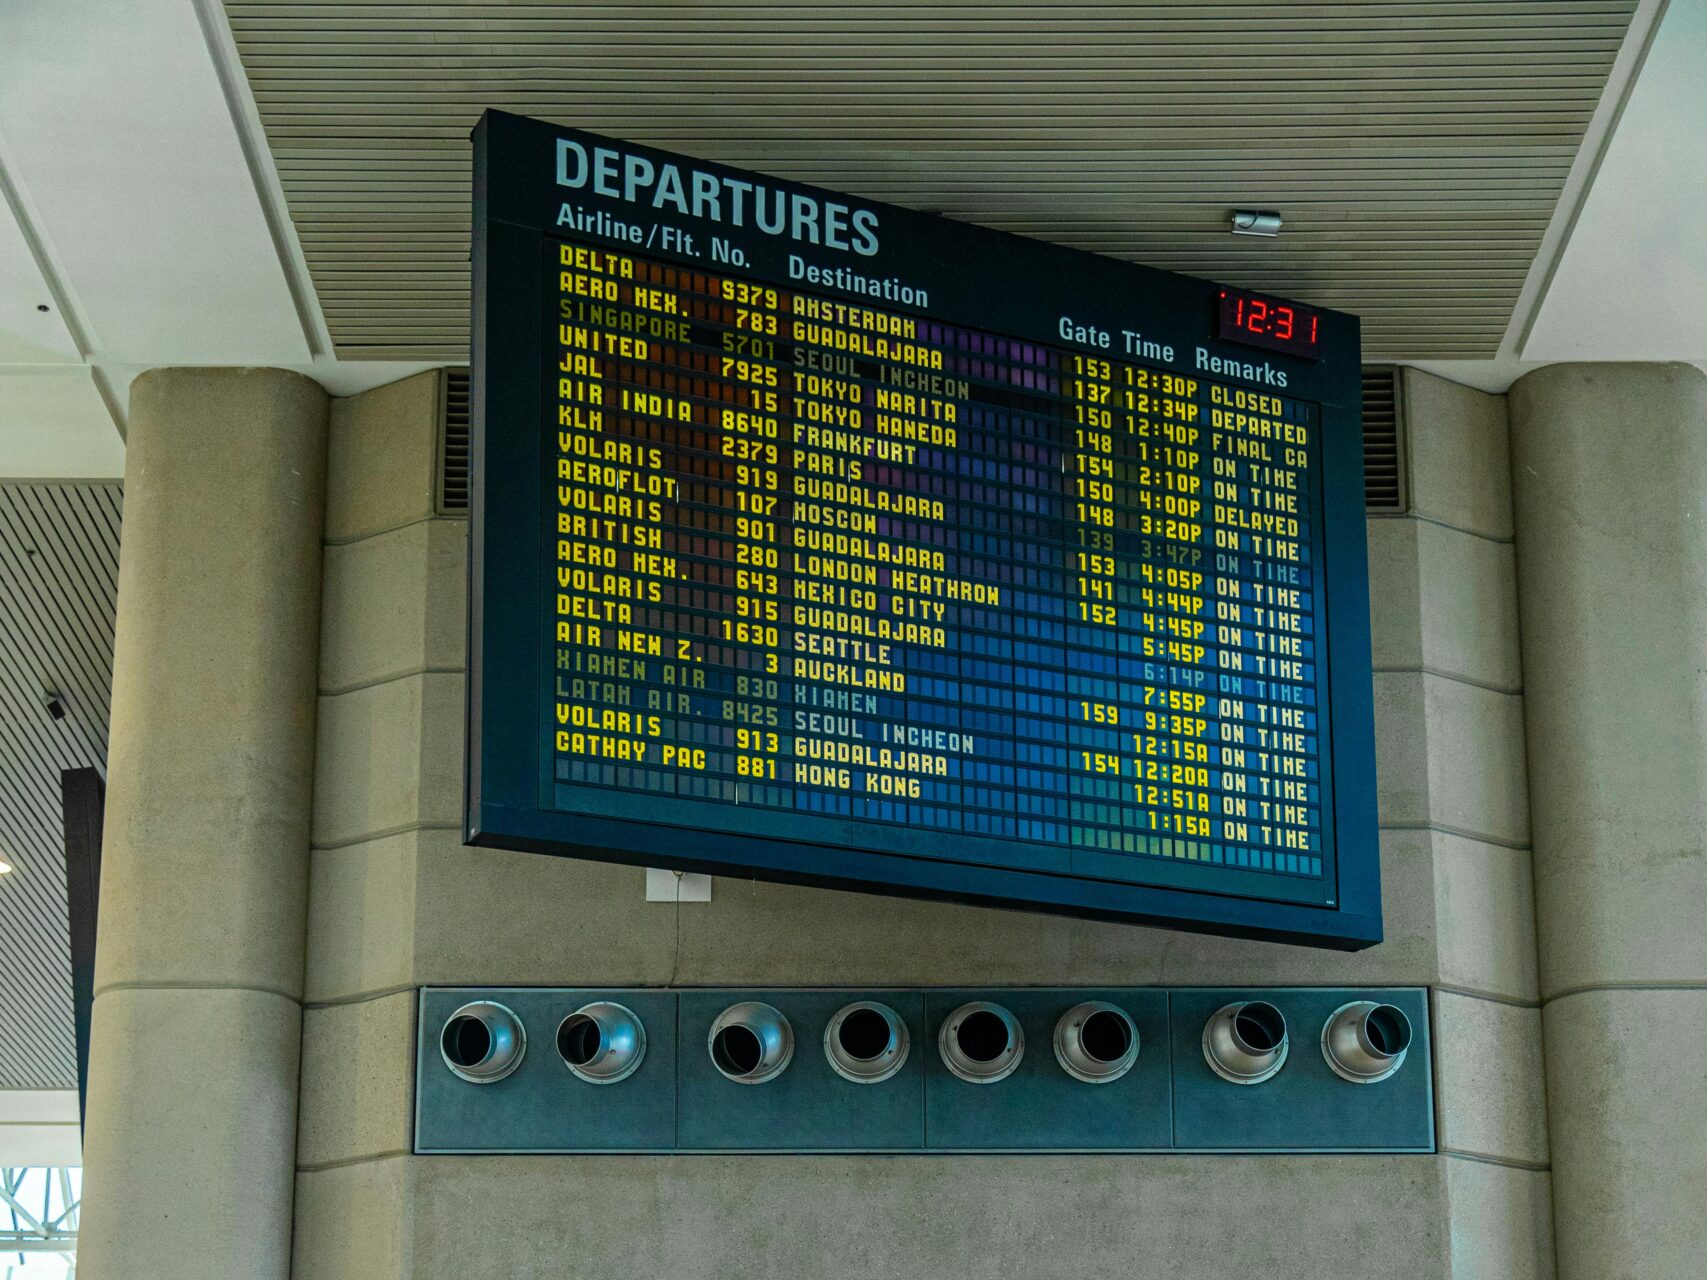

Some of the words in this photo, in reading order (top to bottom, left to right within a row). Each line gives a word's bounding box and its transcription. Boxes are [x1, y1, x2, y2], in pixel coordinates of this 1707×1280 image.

[556, 138, 880, 256] DEPARTURES
[556, 203, 700, 258] Airline/Flt.
[712, 236, 751, 269] No.
[789, 255, 928, 308] Destination
[1059, 317, 1110, 349] Gate
[1122, 330, 1174, 362] Time
[1196, 347, 1288, 388] Remarks
[560, 245, 633, 280] DELTA
[792, 295, 913, 339] AMSTERDAM
[1074, 355, 1110, 381] 153
[1124, 366, 1197, 399] 12:30P
[1211, 384, 1281, 417] CLOSED
[560, 271, 618, 303] AERO
[634, 287, 690, 318] MEX.
[736, 308, 777, 336] 783
[792, 320, 940, 370] GUADALAJARA
[1075, 379, 1110, 405] 137
[1125, 390, 1198, 423] 12:34P
[1212, 408, 1306, 445] DEPARTED
[1236, 299, 1317, 344] 12:31
[559, 351, 603, 379] JAL
[751, 388, 777, 413] 15
[793, 397, 861, 429] TOKYO
[876, 413, 956, 448] HANEDA
[1076, 452, 1112, 478] 154
[1139, 465, 1200, 495] 2:10P
[559, 377, 603, 405] AIR
[622, 389, 690, 422] INDIA
[722, 409, 777, 439] 8640
[793, 422, 915, 465] FRANKFURT
[1077, 477, 1113, 502] 150
[1139, 489, 1200, 519] 4:00P
[1215, 504, 1298, 537] DELAYED
[560, 324, 647, 361] UNITED
[722, 357, 777, 387] 7925
[793, 371, 861, 404] TOKYO
[876, 388, 956, 423] NARITA
[1076, 428, 1112, 453] 148
[1138, 441, 1199, 471] 1:10P
[1213, 456, 1236, 478] ON
[1249, 463, 1296, 490] TIME
[1075, 404, 1111, 429] 150
[1125, 414, 1198, 447] 12:40P
[1212, 432, 1271, 461] FINAL
[1284, 447, 1307, 469] CA
[558, 457, 676, 498] AEROFLOT
[736, 489, 778, 516] 107
[793, 500, 875, 534] MOSCOW
[559, 404, 603, 432] KLM
[722, 435, 778, 464] 2379
[793, 448, 861, 480] PARIS
[1077, 502, 1113, 527] 148
[1140, 513, 1201, 543] 3:20P
[558, 511, 661, 549] BRITISH
[736, 542, 778, 569] 280
[794, 552, 876, 585] LONDON
[891, 568, 998, 606] HEATHROW
[1079, 601, 1115, 625] 152
[1142, 611, 1204, 640] 4:45P
[557, 593, 631, 625] DELTA
[722, 619, 778, 647] 1630
[794, 630, 890, 665] SEATTLE
[1144, 686, 1206, 714] 7:55P
[557, 620, 601, 647] AIR
[618, 629, 661, 656] NEW
[765, 652, 778, 674] 3
[794, 656, 904, 693] AUCKLAND
[1081, 701, 1118, 725] 159
[1145, 710, 1207, 738] 9:35P
[556, 730, 646, 763] CATHAY
[662, 745, 705, 771] PAC
[737, 755, 779, 781] 881
[795, 763, 850, 790] HONG
[865, 772, 919, 799] KONG
[1147, 811, 1209, 838] 1:15A
[1224, 821, 1247, 843] ON
[1260, 826, 1308, 851] TIME
